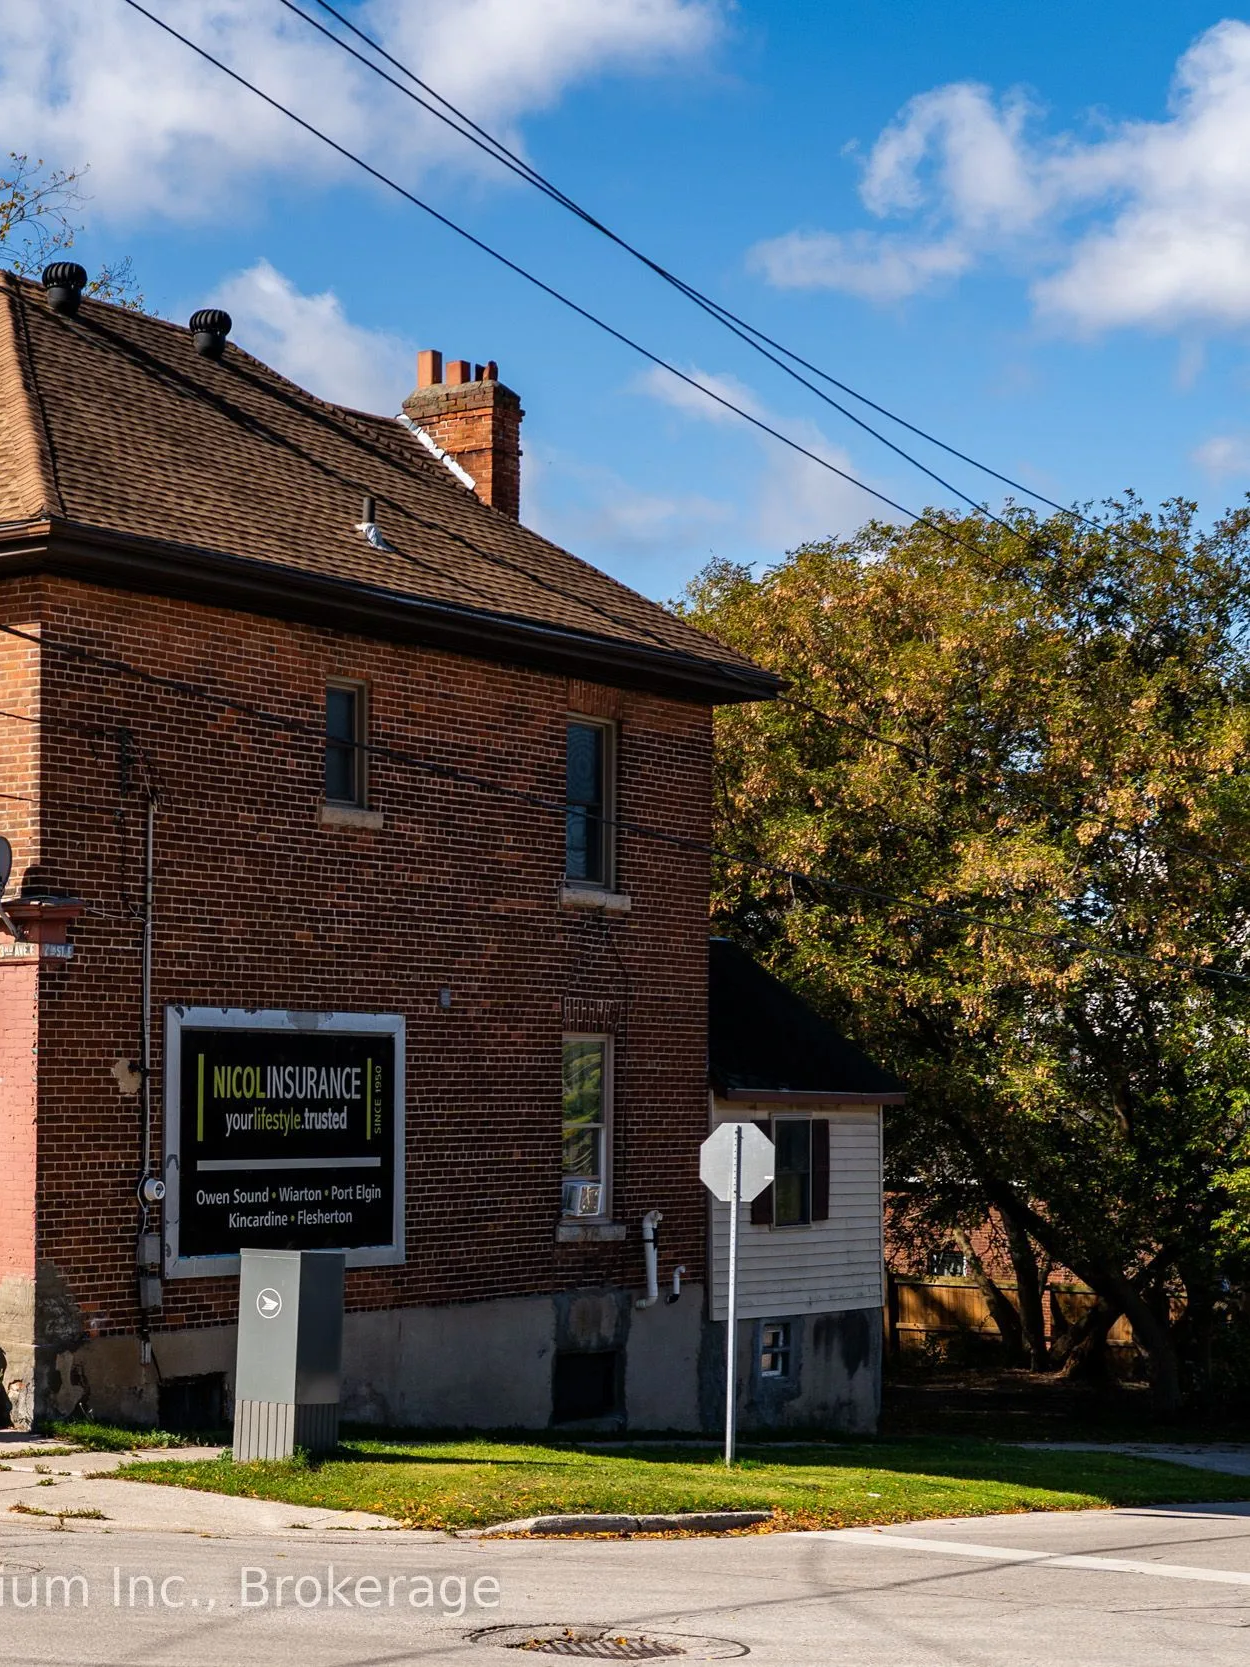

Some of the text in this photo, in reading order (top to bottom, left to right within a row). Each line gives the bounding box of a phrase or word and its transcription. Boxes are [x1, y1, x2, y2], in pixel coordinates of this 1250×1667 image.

[374, 1065, 382, 1134] SINCE 1950
[196, 1184, 382, 1206] Owen Sound Wiarton Port Elgin
[228, 1209, 353, 1229] Kincardine Flesherton
